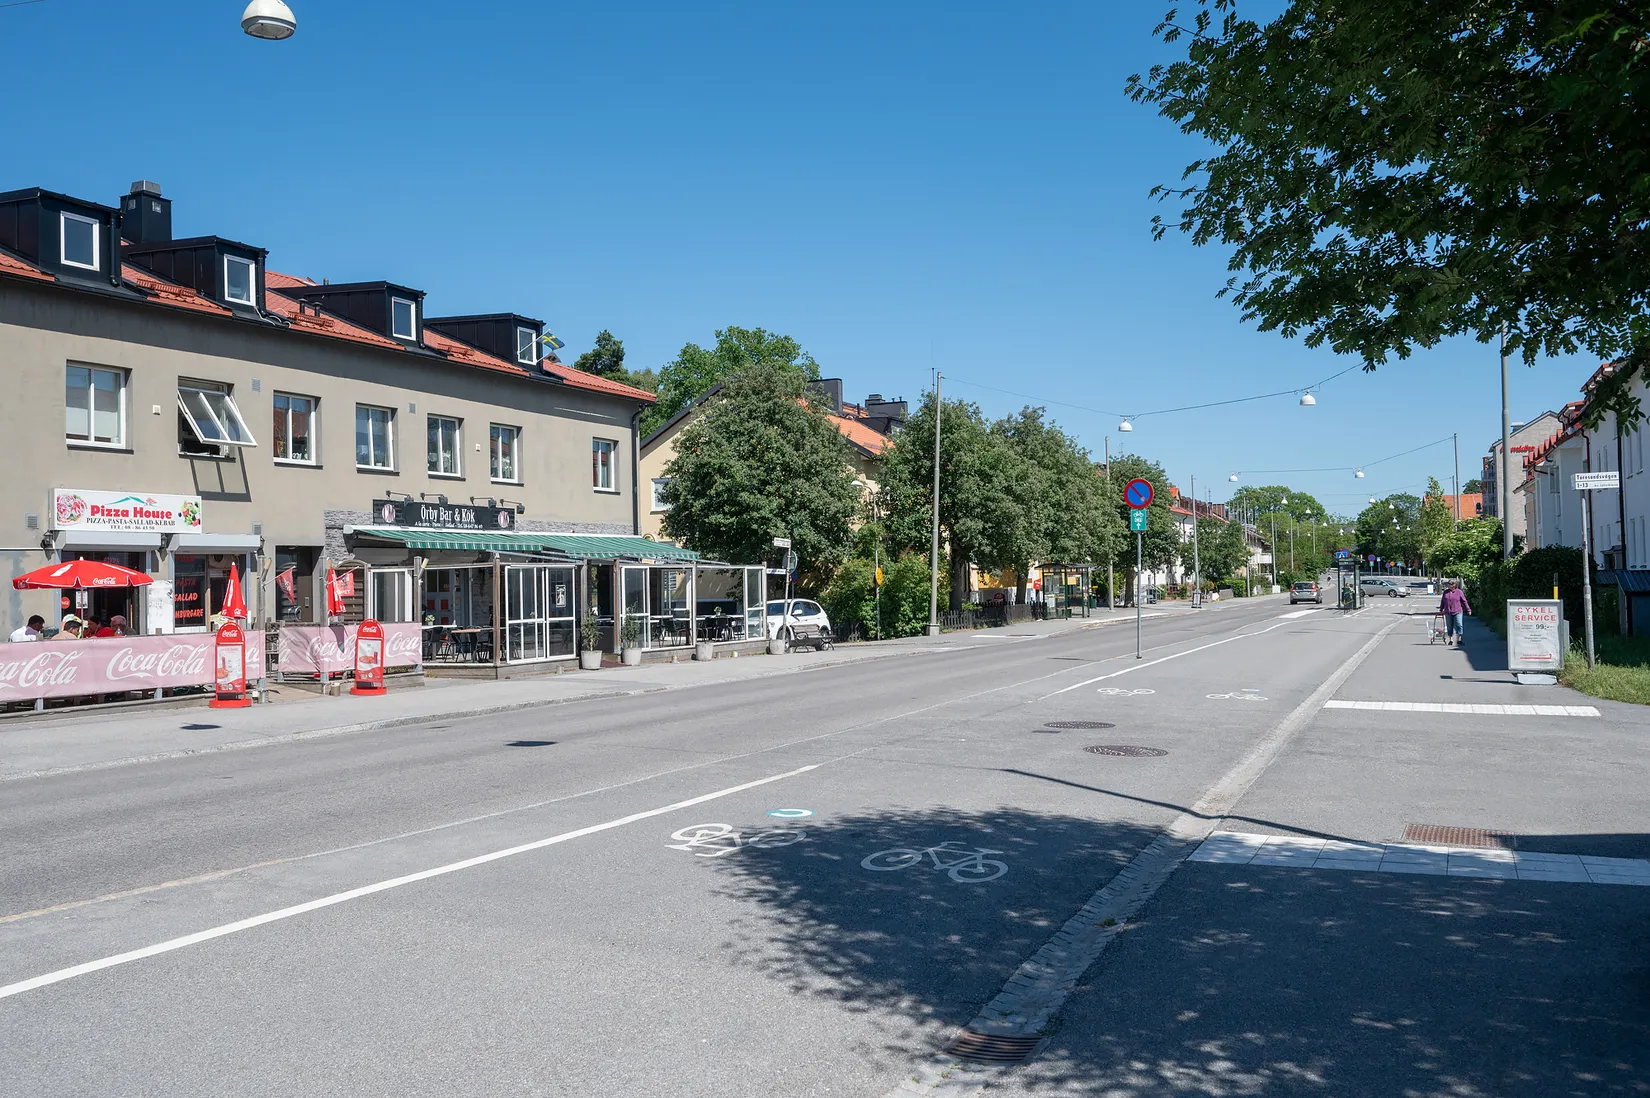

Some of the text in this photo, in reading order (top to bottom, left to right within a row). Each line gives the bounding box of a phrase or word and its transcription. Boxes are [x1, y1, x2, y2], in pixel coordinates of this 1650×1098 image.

[90, 505, 172, 519] Pizza House
[420, 505, 475, 522] Örby Bar & Kök
[86, 517, 175, 526] PIZZA-PASTA-SALLAD-KEBAB
[174, 592, 198, 601] SALLAD
[385, 631, 422, 658] Coca
[106, 643, 210, 681] Coca-Cola
